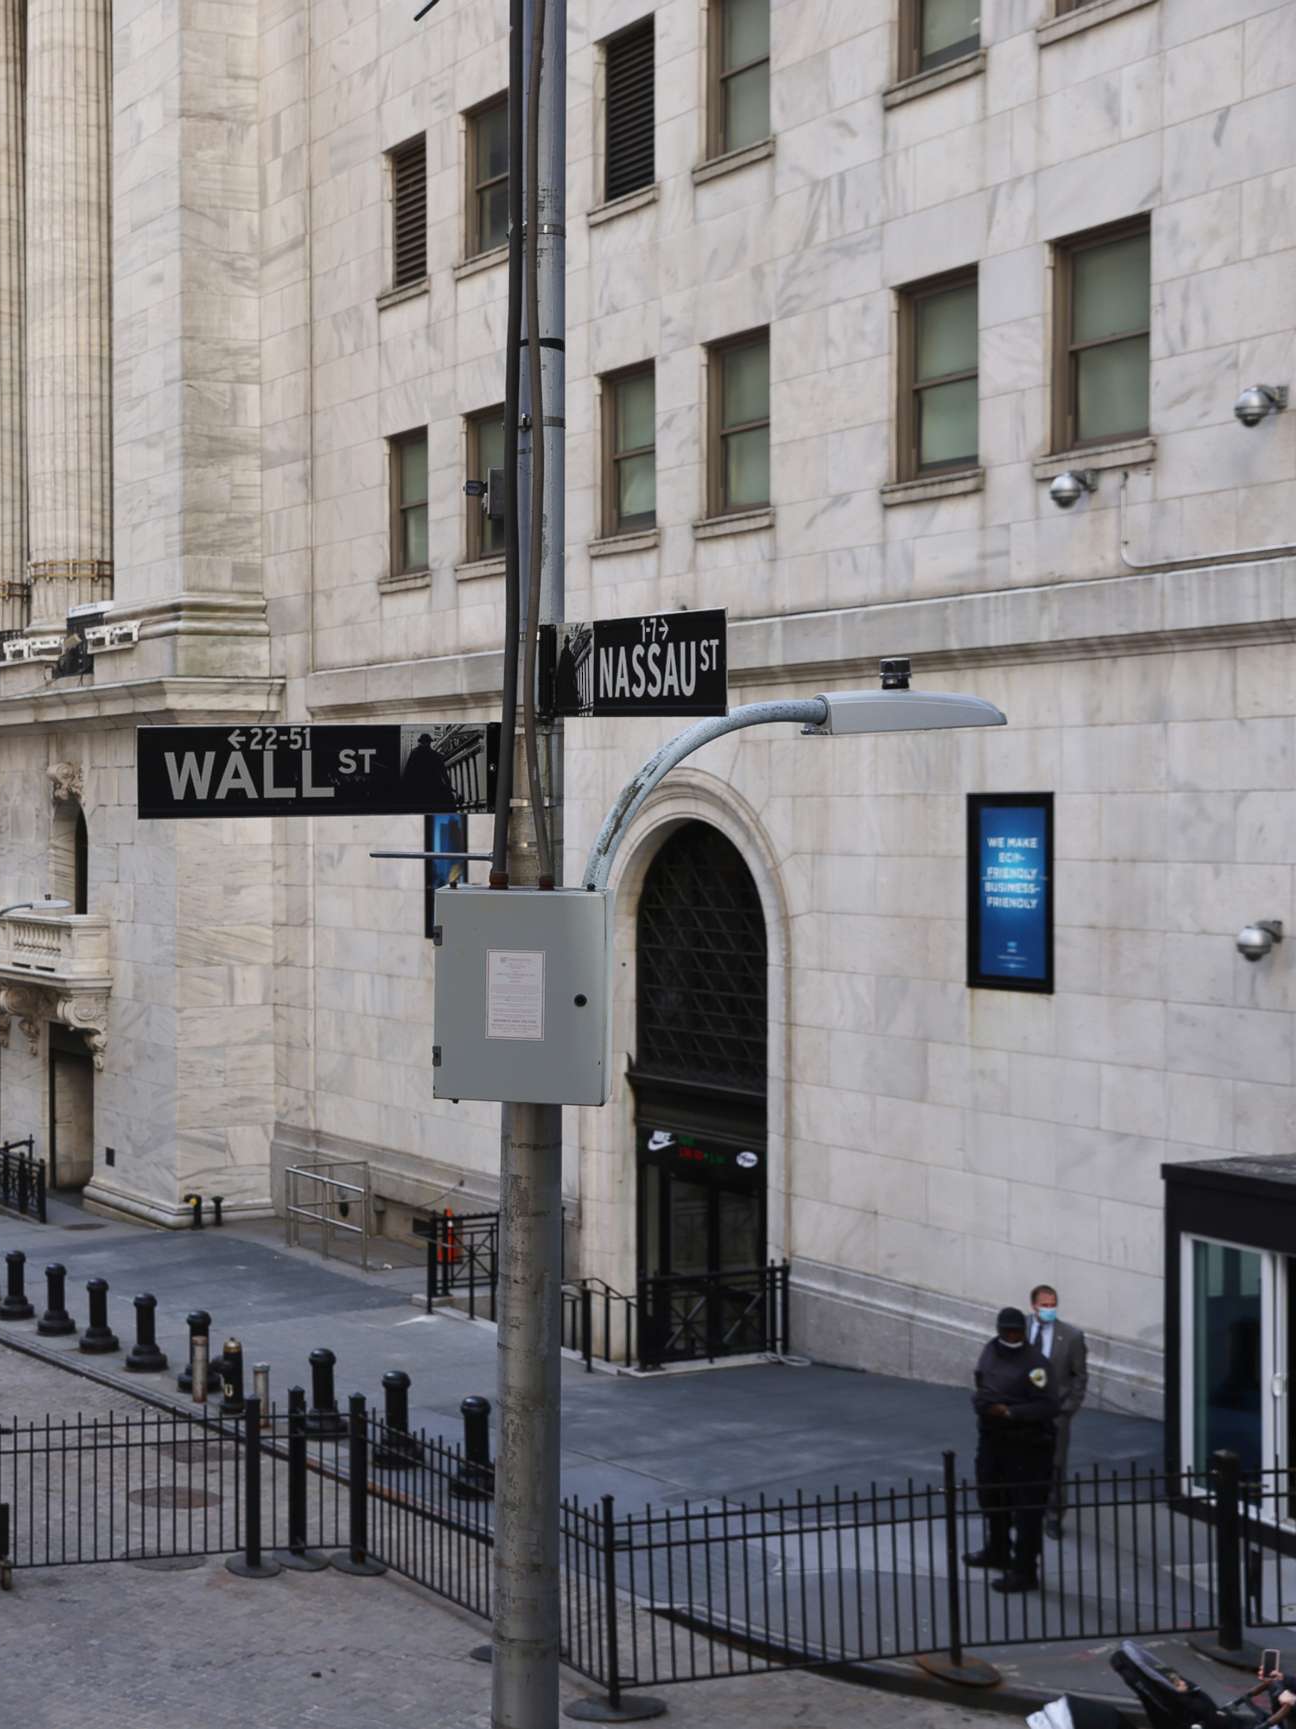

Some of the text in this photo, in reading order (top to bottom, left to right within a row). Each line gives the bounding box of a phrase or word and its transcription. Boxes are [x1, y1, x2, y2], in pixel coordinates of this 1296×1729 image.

[640, 618, 657, 642] 1-7
[599, 639, 720, 698] NASSAU ST
[249, 728, 311, 750] 22-51
[164, 748, 377, 800] WALL ST
[986, 836, 1039, 849] WE MAKE
[986, 866, 1038, 881] FRIENDLY
[986, 896, 1038, 910] FRIENDLY
